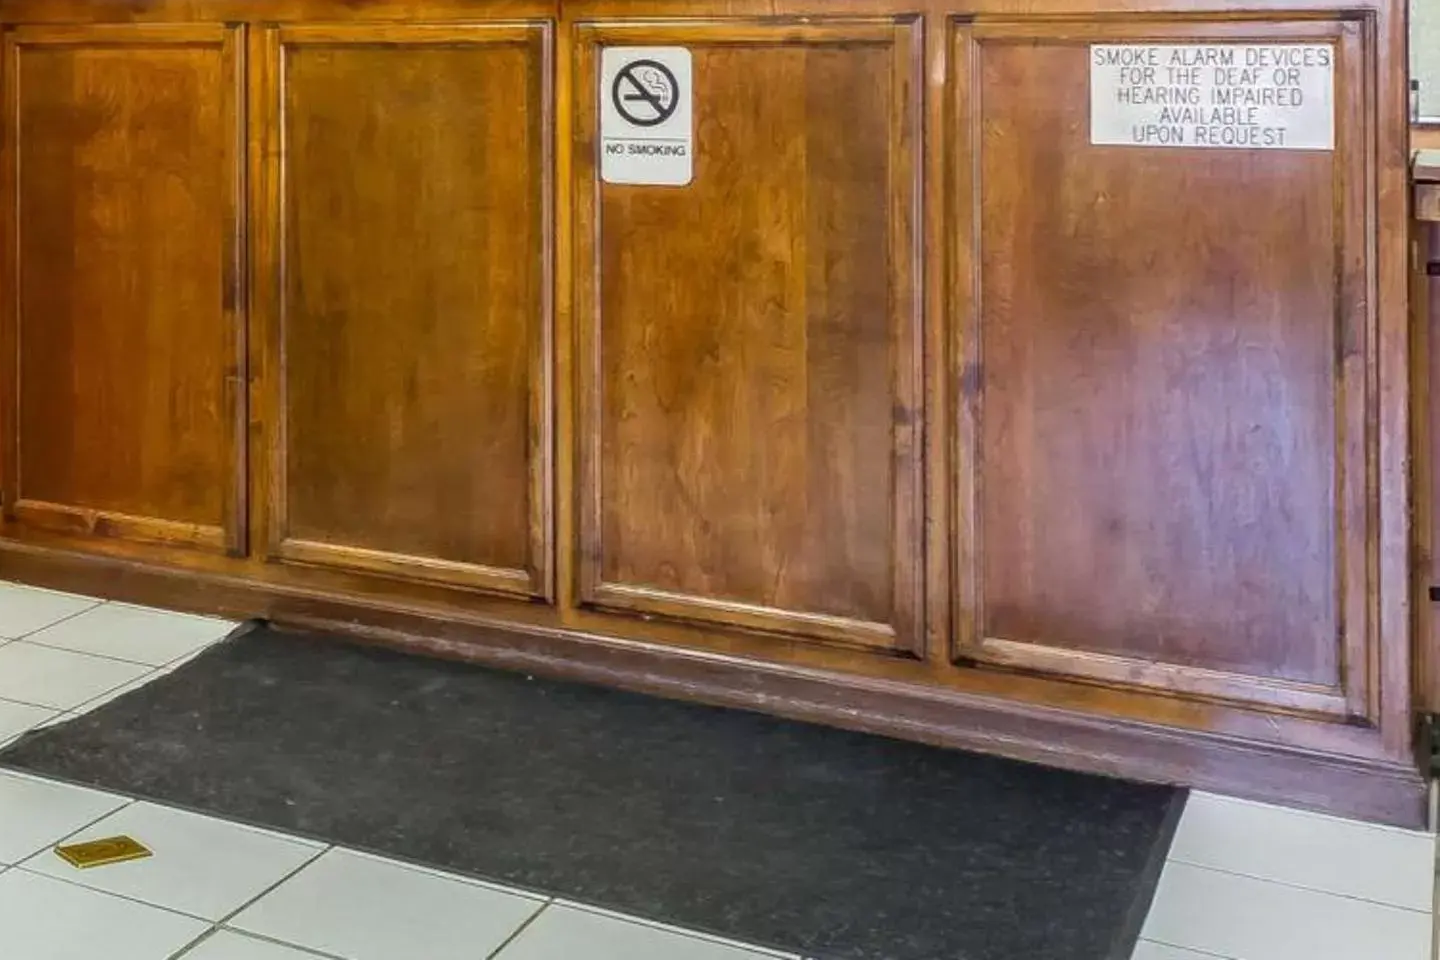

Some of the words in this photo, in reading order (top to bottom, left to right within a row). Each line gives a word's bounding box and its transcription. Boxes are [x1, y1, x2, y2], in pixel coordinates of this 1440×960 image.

[1094, 48, 1159, 66] SMOKE
[1170, 48, 1234, 66] ALARM
[1245, 48, 1330, 67] DEVICES
[1119, 68, 1155, 85] FOR
[1167, 68, 1201, 85] THE
[1214, 68, 1262, 86] DEAF
[1273, 68, 1301, 86] OR
[1117, 87, 1200, 105] HEARING
[1211, 87, 1303, 106] IMPAIRED
[1159, 107, 1259, 125] AVAILABLE
[1132, 125, 1184, 145] UPON
[1195, 126, 1286, 146] REQUEST
[606, 144, 624, 155] NO
[628, 144, 686, 156] SMOKING
